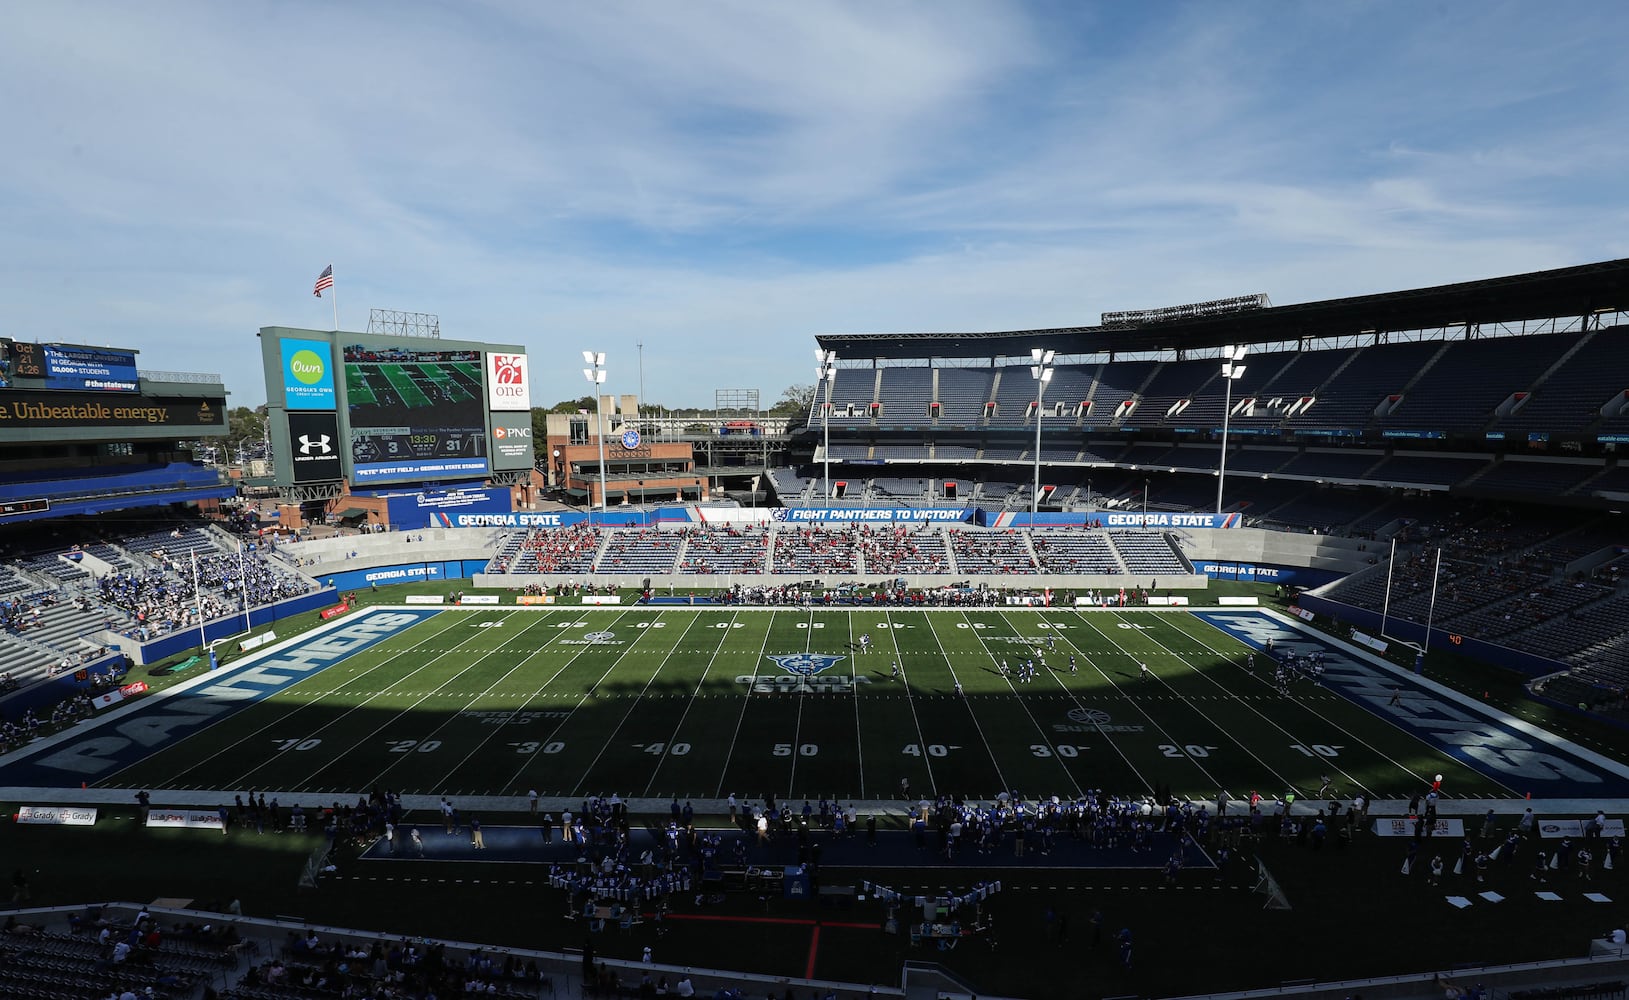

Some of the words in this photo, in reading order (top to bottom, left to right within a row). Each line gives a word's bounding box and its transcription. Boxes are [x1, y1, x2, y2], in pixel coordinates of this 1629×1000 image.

[15, 344, 33, 354] Oct
[21, 355, 32, 364] 21
[17, 365, 39, 375] 4:26
[79, 367, 110, 376] STUDENTS
[293, 360, 323, 373] Own
[84, 380, 136, 391] #thestateway
[496, 386, 524, 397] one
[12, 402, 111, 419] Unbeatable
[113, 405, 169, 423] energy.
[507, 428, 531, 438] PNC
[410, 435, 436, 444] 13:30
[446, 440, 461, 451] 31
[388, 442, 398, 453] 3
[458, 514, 517, 526] GEORGIA
[520, 514, 561, 526] STATE
[792, 510, 828, 520] FIGHT
[830, 510, 892, 519] PANTHERS
[895, 509, 911, 519] TO
[913, 510, 964, 520] VICTORY
[1108, 514, 1168, 526] GEORGIA
[1171, 515, 1214, 527] STATE
[366, 570, 406, 581] GEORGIA
[408, 567, 438, 577] STATE
[1203, 565, 1246, 574] GEORGIA
[1248, 567, 1279, 577] STATE
[1450, 635, 1462, 645] 40
[75, 669, 87, 681] 40
[734, 675, 873, 685] GEORGIA
[34, 612, 421, 775] PANTHERS
[753, 684, 852, 693] STATE
[1207, 614, 1604, 784] PANTHERS
[278, 738, 322, 751] 10
[389, 739, 442, 752] 20
[517, 742, 565, 754] 30
[644, 743, 691, 755] 40
[772, 744, 818, 756] 50
[902, 744, 948, 757] 40
[1030, 744, 1078, 757] 30
[1158, 744, 1209, 757] 20
[1289, 744, 1339, 757] 10
[33, 811, 56, 821] Grady
[72, 812, 94, 821] Grady
